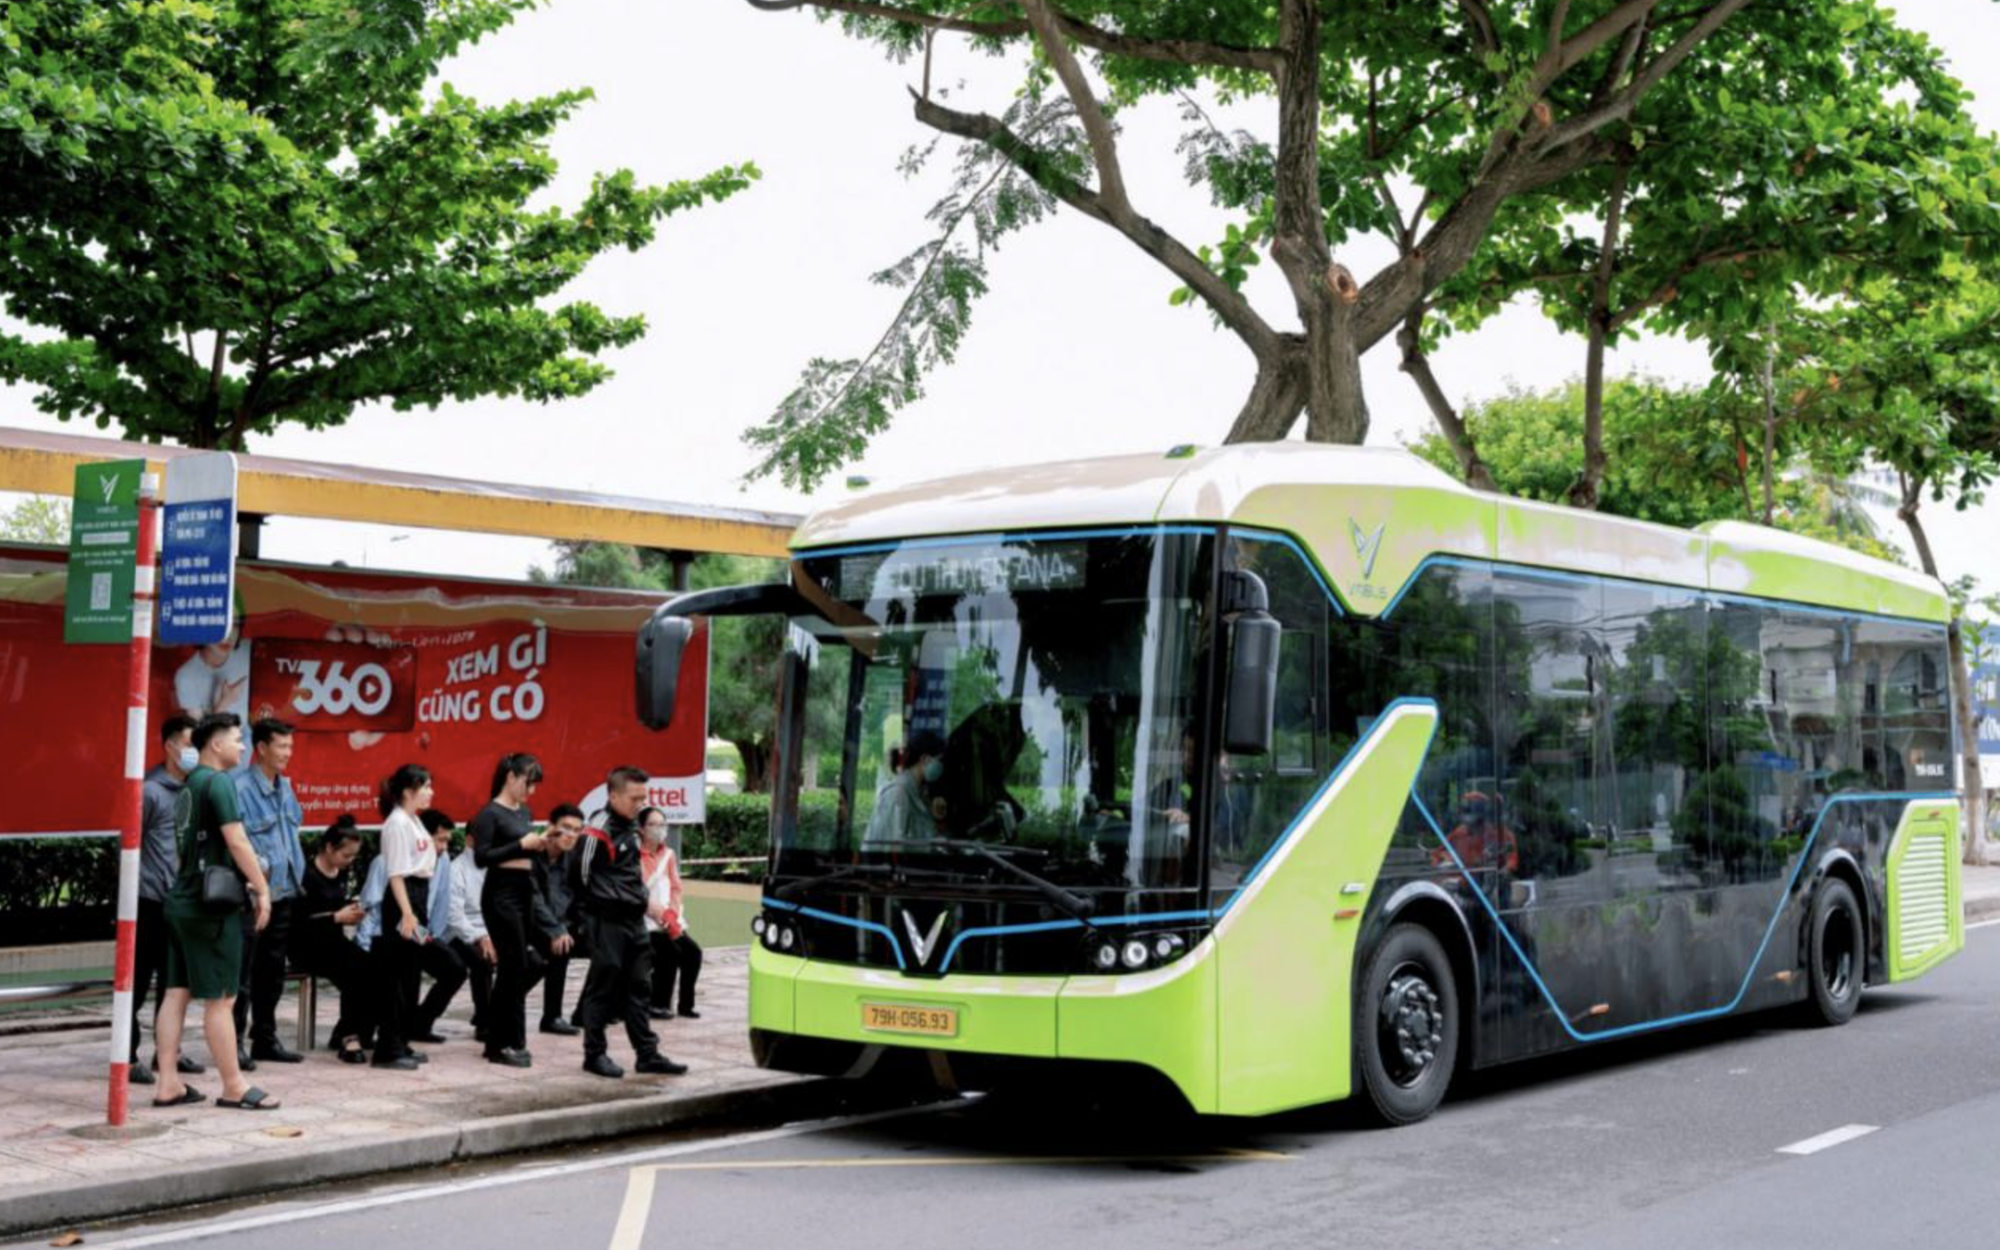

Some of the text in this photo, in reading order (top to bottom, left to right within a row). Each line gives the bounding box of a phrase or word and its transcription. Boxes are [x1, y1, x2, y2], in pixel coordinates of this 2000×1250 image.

[445, 619, 548, 686] XEM GÌ
[292, 658, 392, 716] 360
[418, 668, 545, 723] CŨNG CÓ
